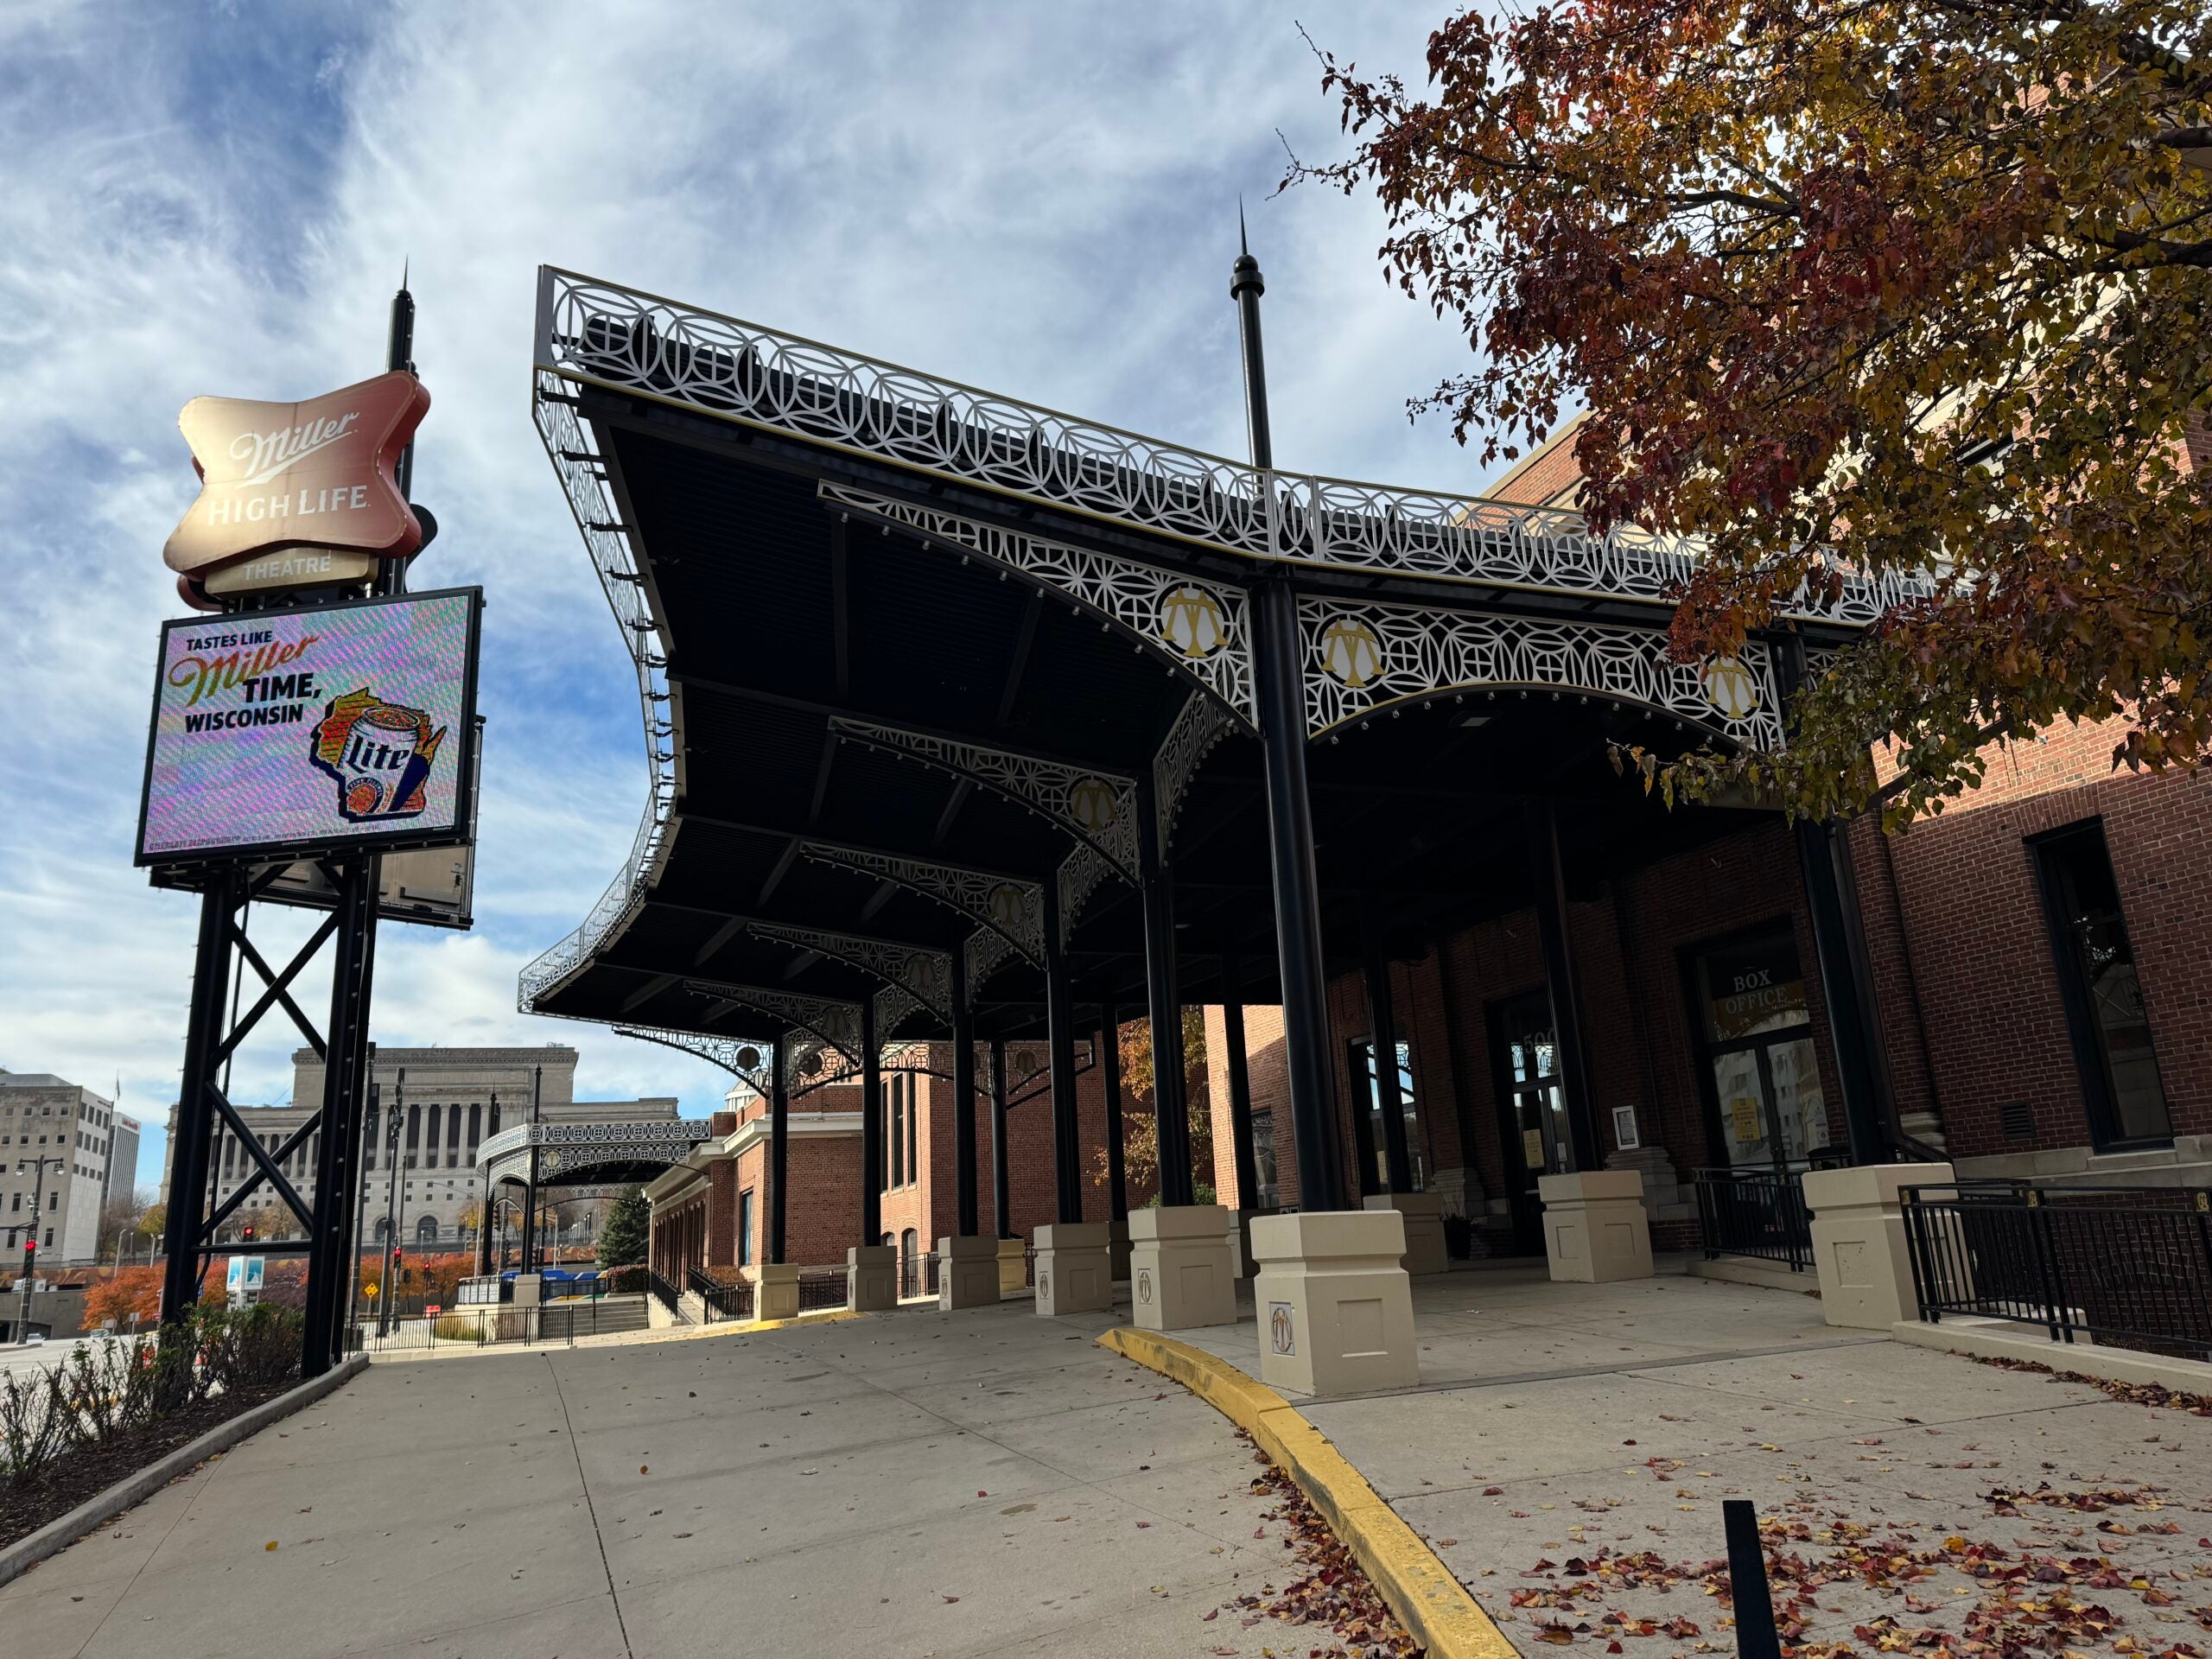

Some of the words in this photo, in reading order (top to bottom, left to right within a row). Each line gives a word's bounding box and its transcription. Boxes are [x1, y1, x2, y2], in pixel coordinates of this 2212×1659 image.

[229, 411, 359, 482] Miller
[208, 494, 289, 526] HIGH
[243, 556, 332, 581] THEATRE
[186, 634, 238, 652] TASTES
[240, 631, 272, 646] LIKE
[168, 634, 320, 708] Miller
[243, 672, 322, 703] TIME,
[185, 703, 304, 733] WISCONSIN
[345, 735, 410, 774] Lite
[1733, 969, 1772, 993] BOX
[1726, 987, 1787, 1014] OFFICE
